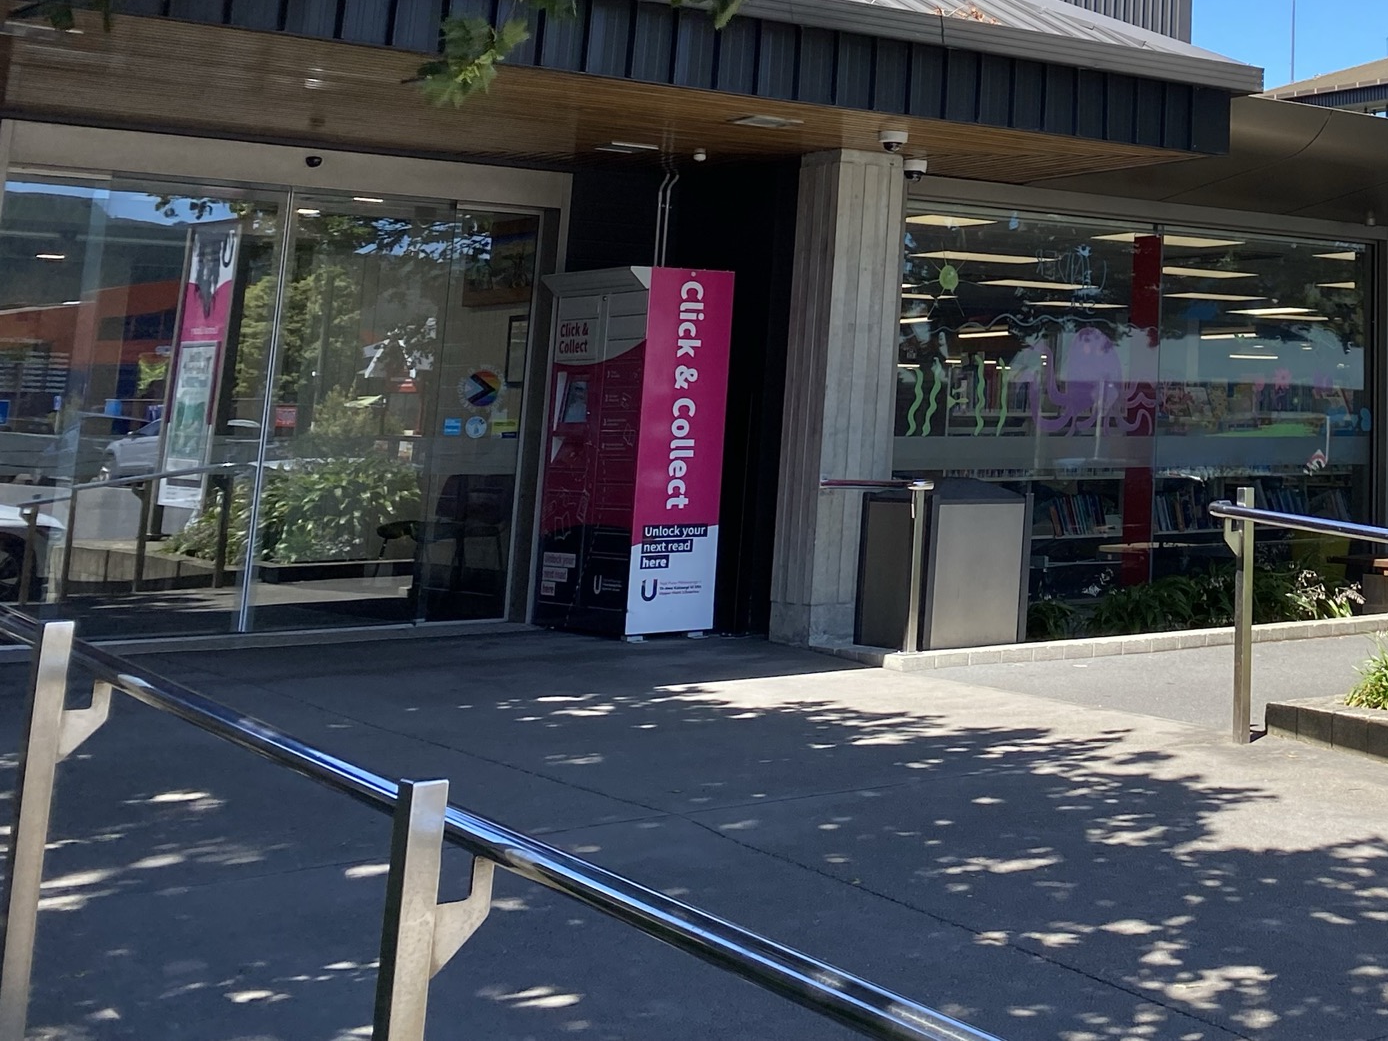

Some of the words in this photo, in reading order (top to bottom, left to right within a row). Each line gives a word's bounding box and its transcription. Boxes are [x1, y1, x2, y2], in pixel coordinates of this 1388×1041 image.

[676, 280, 705, 358] Click
[560, 322, 580, 337] Click
[582, 322, 589, 335] &
[559, 340, 588, 354] Collect
[674, 365, 699, 389] &
[666, 397, 697, 510] Collect
[644, 525, 680, 537] Unlock
[682, 526, 706, 538] your
[643, 542, 667, 552] next
[668, 540, 691, 551] read
[642, 555, 667, 568] here
